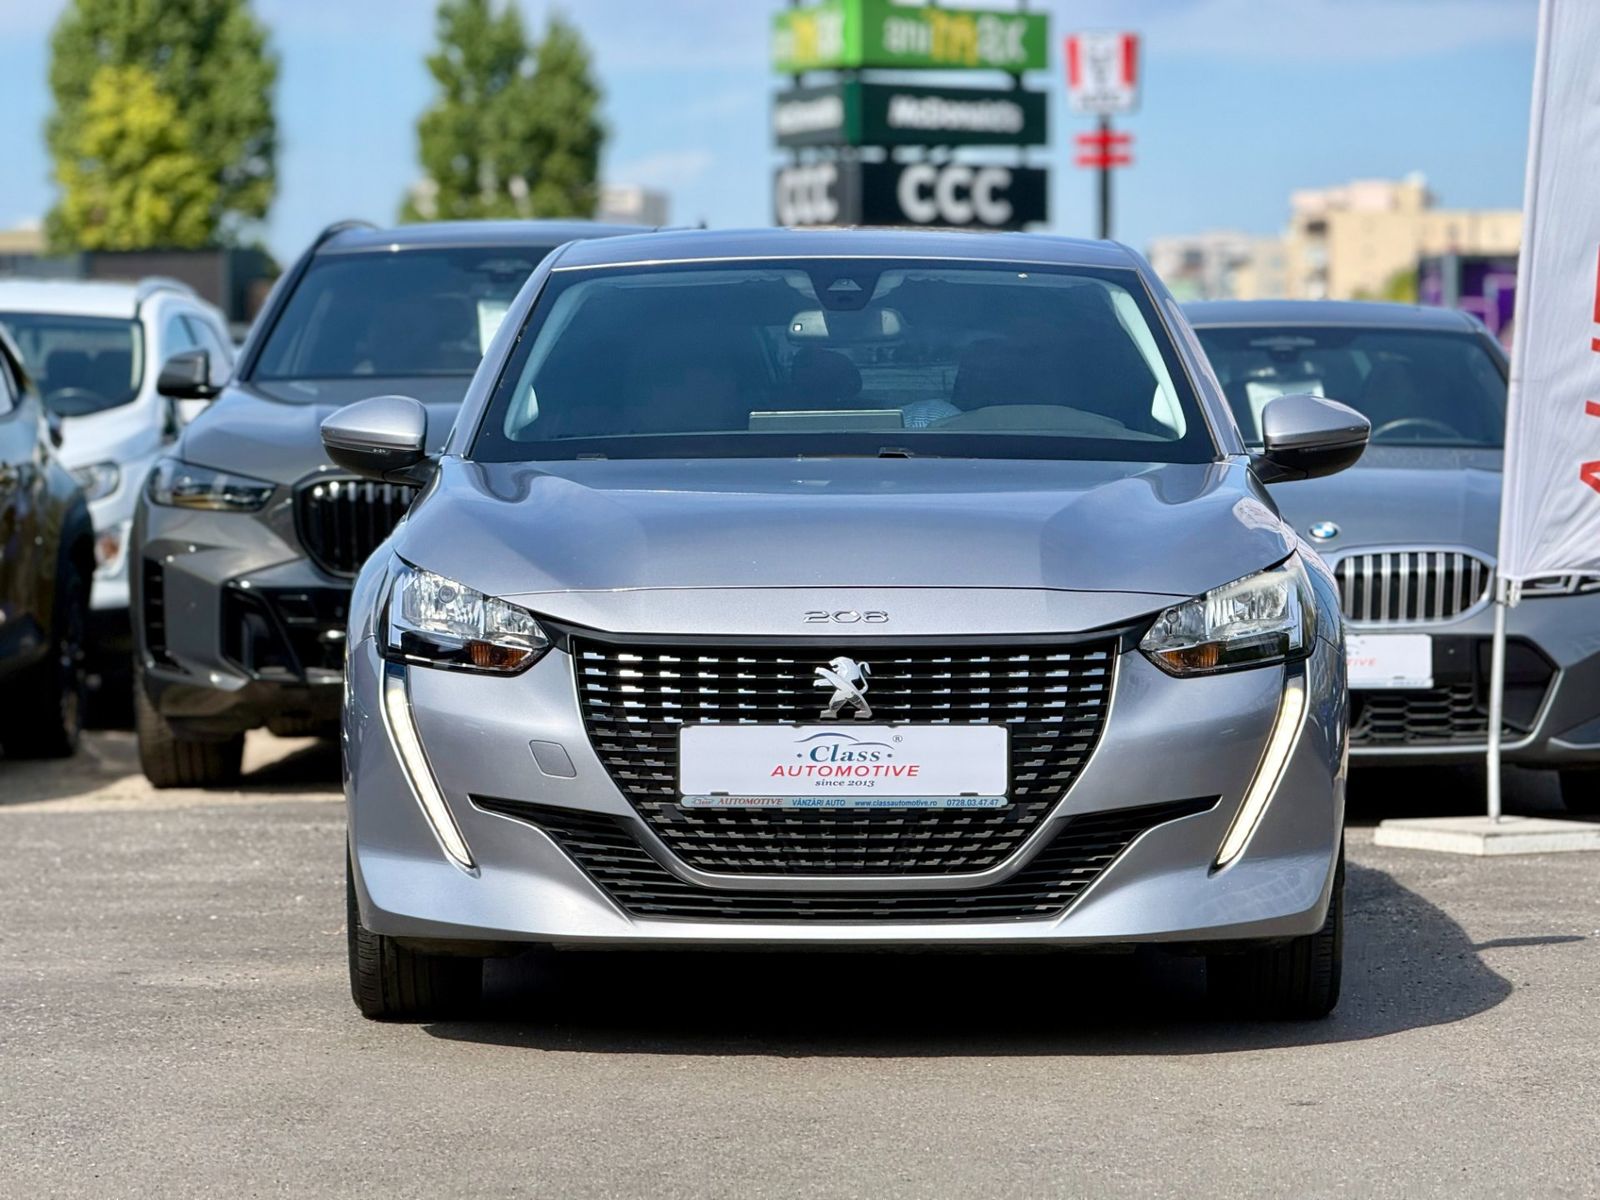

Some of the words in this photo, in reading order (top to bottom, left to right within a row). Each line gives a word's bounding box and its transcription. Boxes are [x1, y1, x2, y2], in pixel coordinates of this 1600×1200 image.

[898, 163, 1013, 224] CCC
[803, 610, 889, 624] 208
[809, 745, 881, 762] Class
[770, 765, 920, 777] AUTOMOTIVE
[848, 780, 875, 788] 2013
[718, 798, 783, 806] AUTOMOTIVE
[854, 799, 938, 807] www.classautomotive.ro
